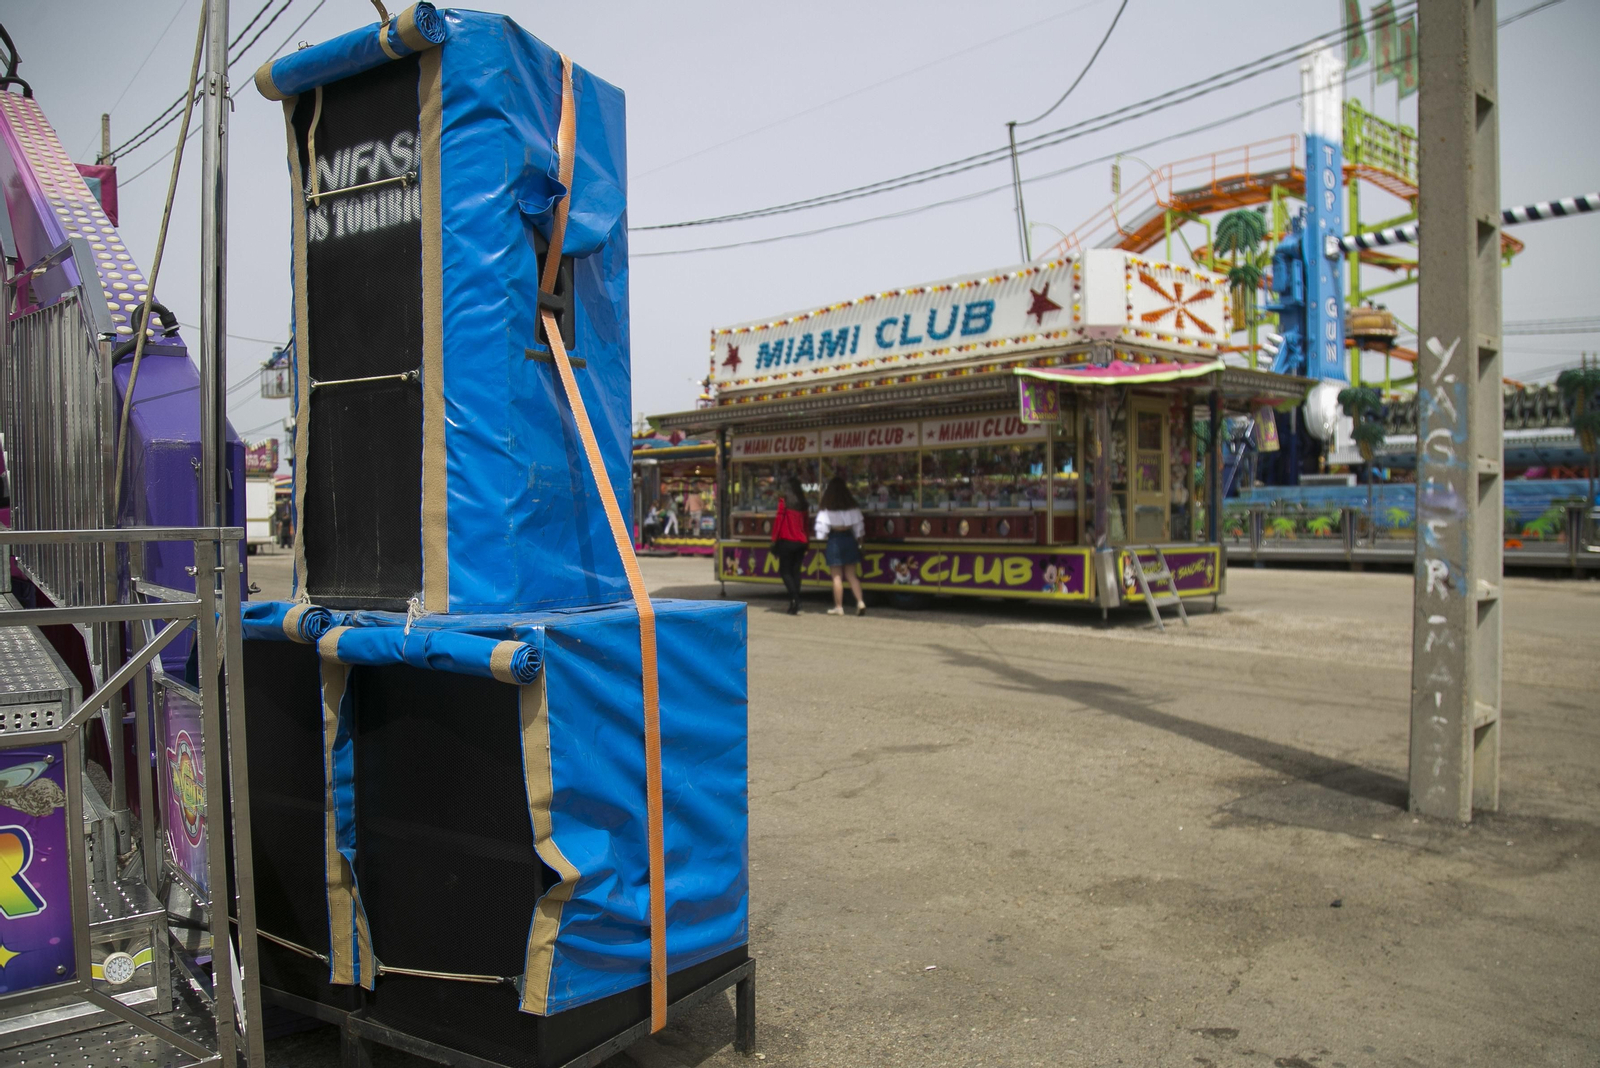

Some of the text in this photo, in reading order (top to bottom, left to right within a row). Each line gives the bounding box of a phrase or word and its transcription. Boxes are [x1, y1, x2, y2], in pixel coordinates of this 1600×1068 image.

[304, 130, 421, 194] NIFAS
[1322, 145, 1337, 212] TOP
[755, 298, 995, 370] MIAMI CLUB
[1324, 297, 1339, 364] GUN
[744, 435, 807, 455] MIAMI CLUB
[833, 427, 904, 449] MIAMI CLUB
[939, 416, 1029, 442] MIAMI CLUB
[920, 555, 1034, 586] CLUB
